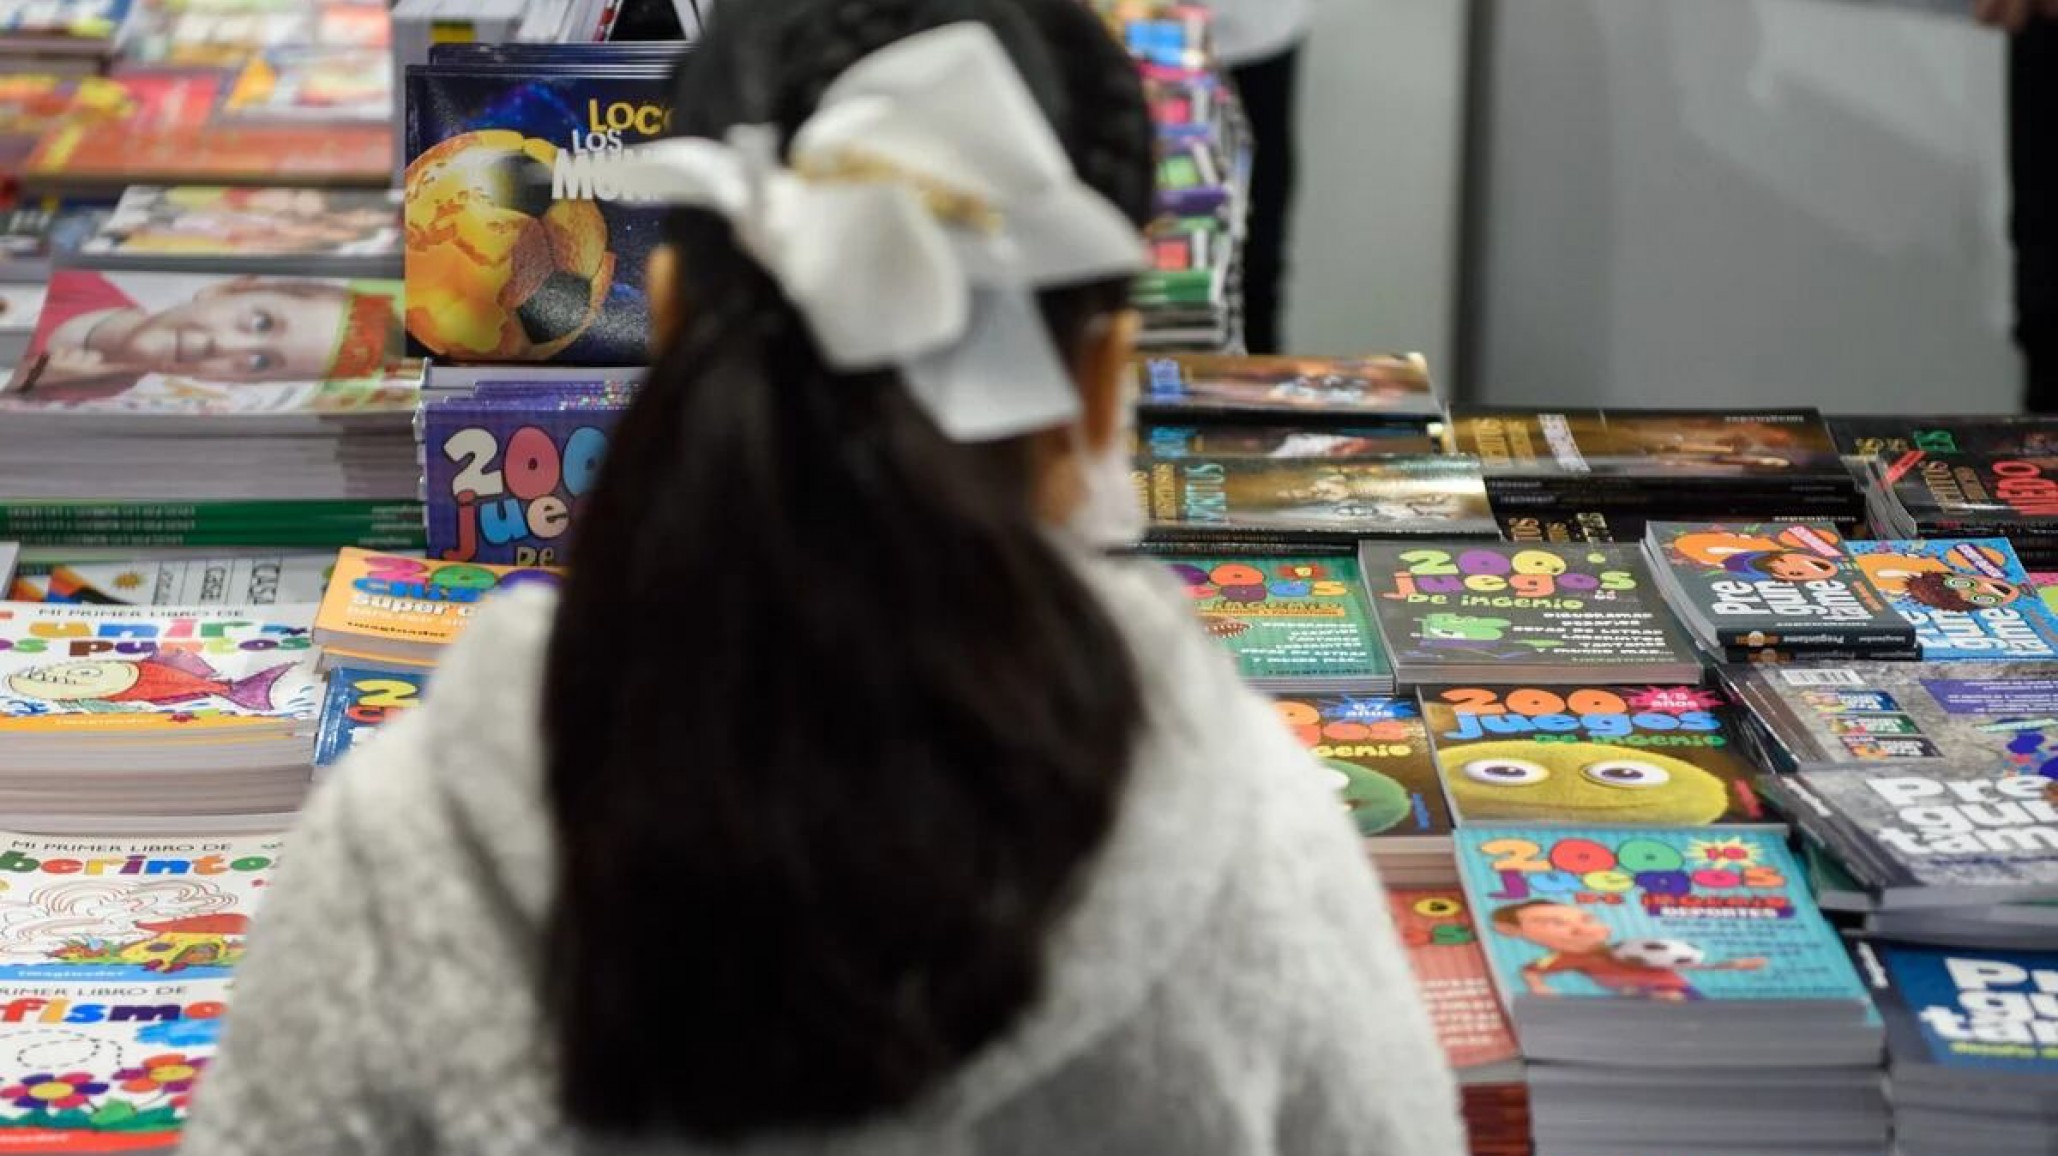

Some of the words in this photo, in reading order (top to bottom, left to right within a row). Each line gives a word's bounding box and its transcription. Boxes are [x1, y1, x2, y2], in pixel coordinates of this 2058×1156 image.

[572, 129, 622, 153] LOS
[444, 426, 608, 498] 200
[443, 490, 570, 562] jue
[1400, 550, 1567, 575] 200
[1711, 580, 1773, 615] Pre
[29, 619, 253, 639] unir
[1441, 688, 1630, 715] 200
[1443, 712, 1723, 740] juegos
[1866, 776, 2053, 806] Pre
[1876, 826, 2058, 856] tam
[0, 850, 272, 876] berinto
[1479, 838, 1686, 875] 200
[0, 998, 229, 1024] fismo
